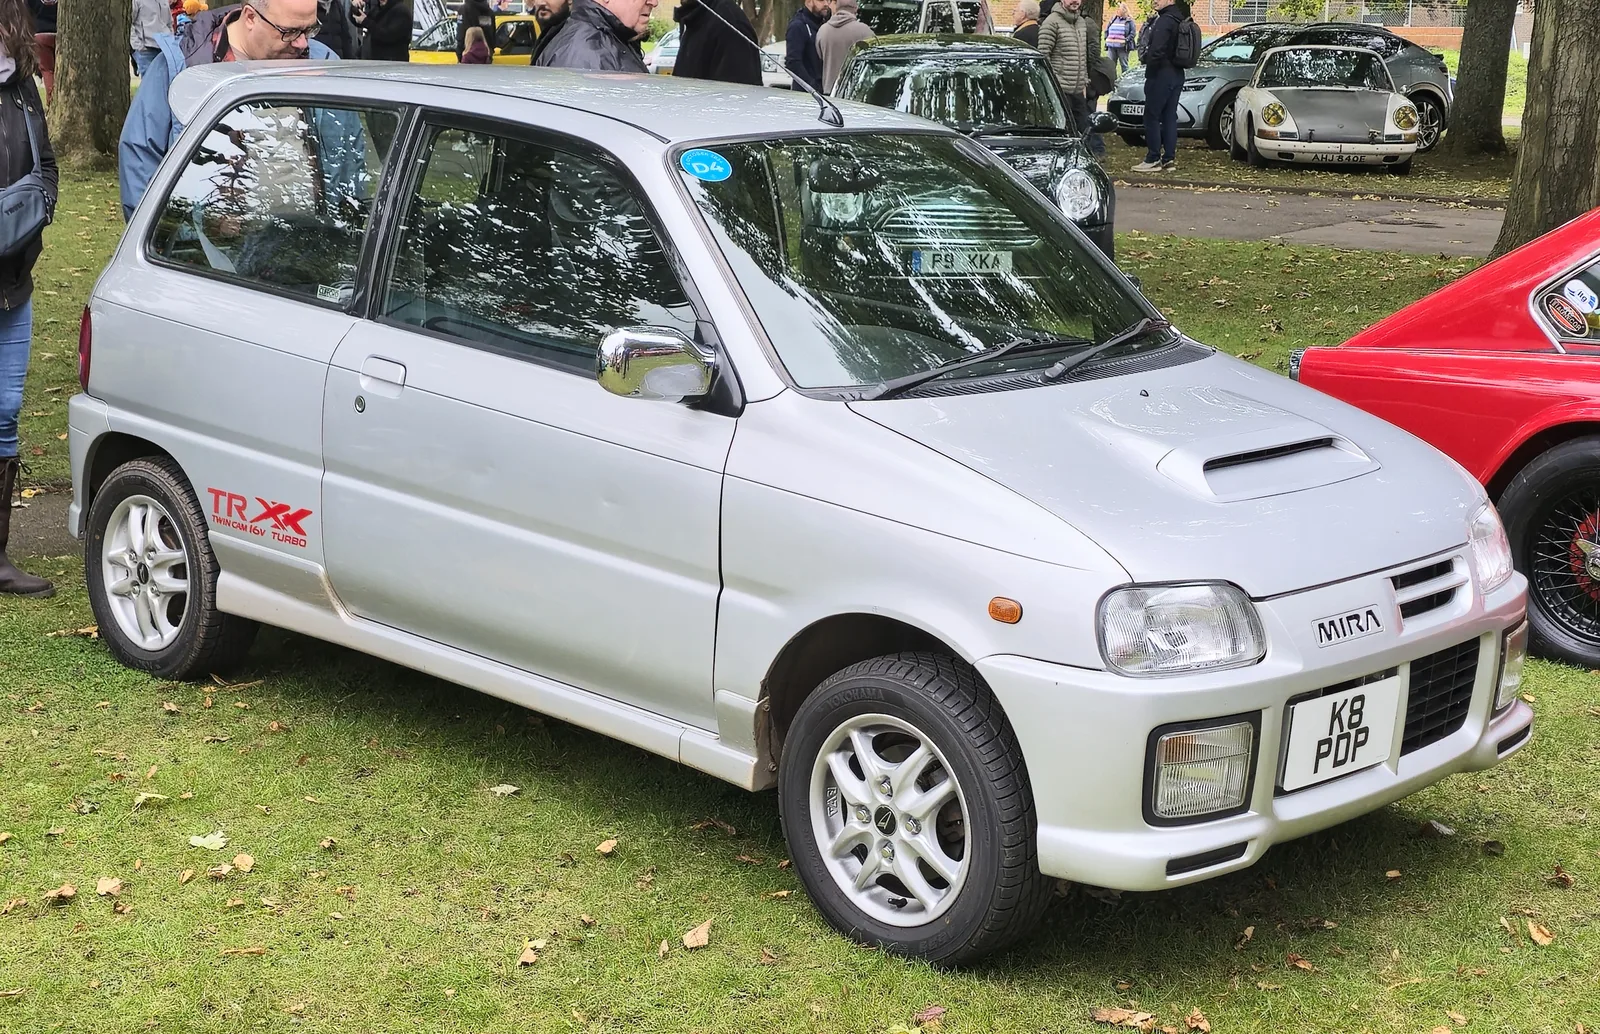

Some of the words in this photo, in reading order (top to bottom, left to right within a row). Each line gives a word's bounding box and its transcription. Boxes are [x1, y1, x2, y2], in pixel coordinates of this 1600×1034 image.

[691, 161, 724, 174] D4
[1311, 153, 1334, 162] AHJ
[211, 514, 231, 528] TWIN
[231, 521, 248, 533] CAM
[271, 531, 307, 548] TURBO
[1317, 609, 1382, 645] MIRA
[826, 687, 885, 709] YOKOHAMA
[1328, 693, 1366, 737] K8
[1313, 725, 1370, 775] PDP
